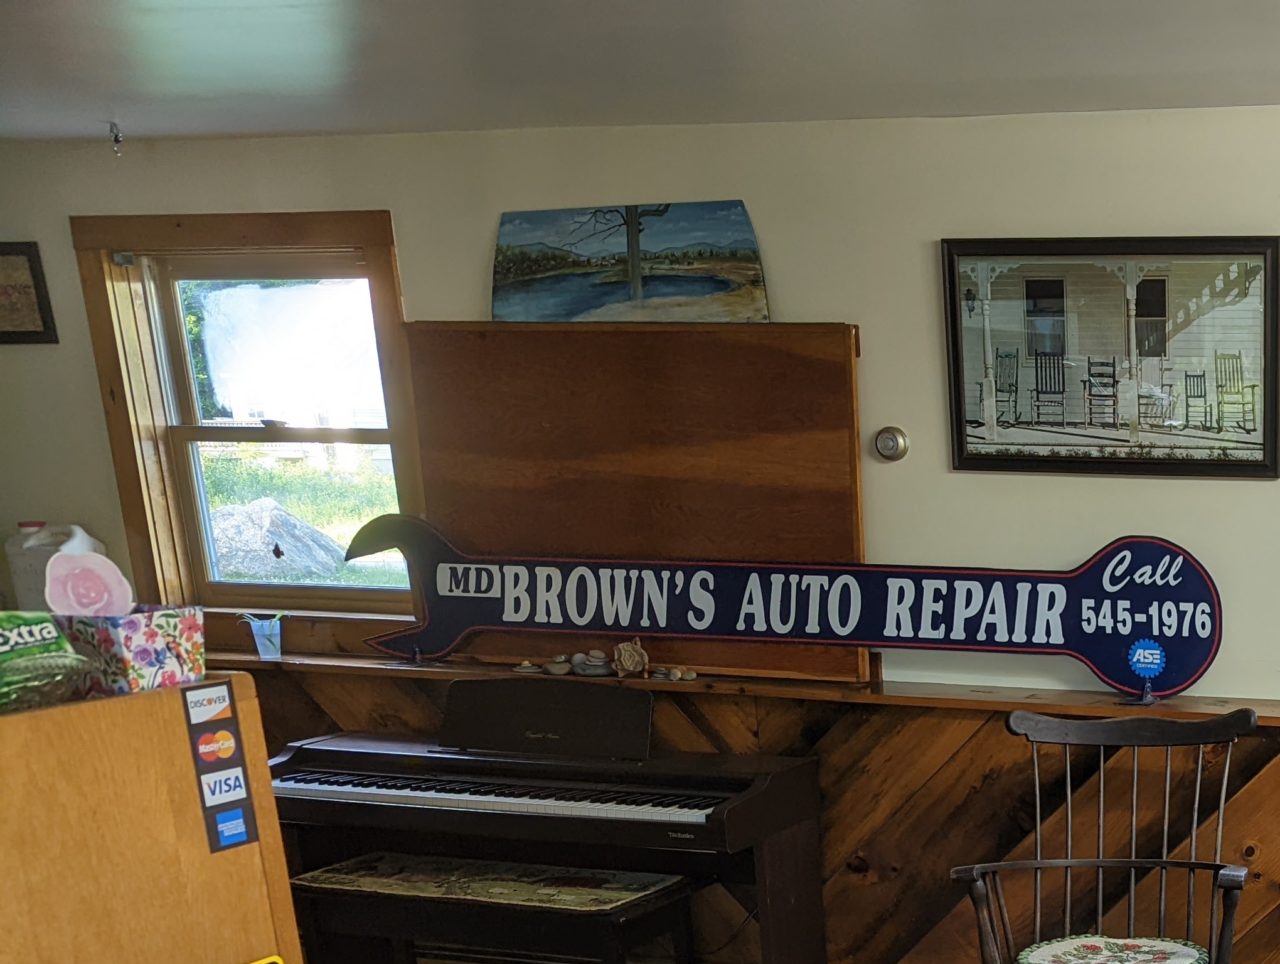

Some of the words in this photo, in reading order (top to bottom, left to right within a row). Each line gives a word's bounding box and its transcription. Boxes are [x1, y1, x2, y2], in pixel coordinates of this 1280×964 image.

[1102, 549, 1184, 593] Call
[447, 566, 495, 595] MD
[501, 565, 715, 631] BROWN'S
[735, 572, 862, 637] AUTO
[883, 577, 1067, 645] REPAIR
[1081, 598, 1212, 639] 545-1976
[1132, 648, 1161, 664] ASE
[189, 695, 227, 710] DISCOVER
[205, 775, 244, 797] VISA
